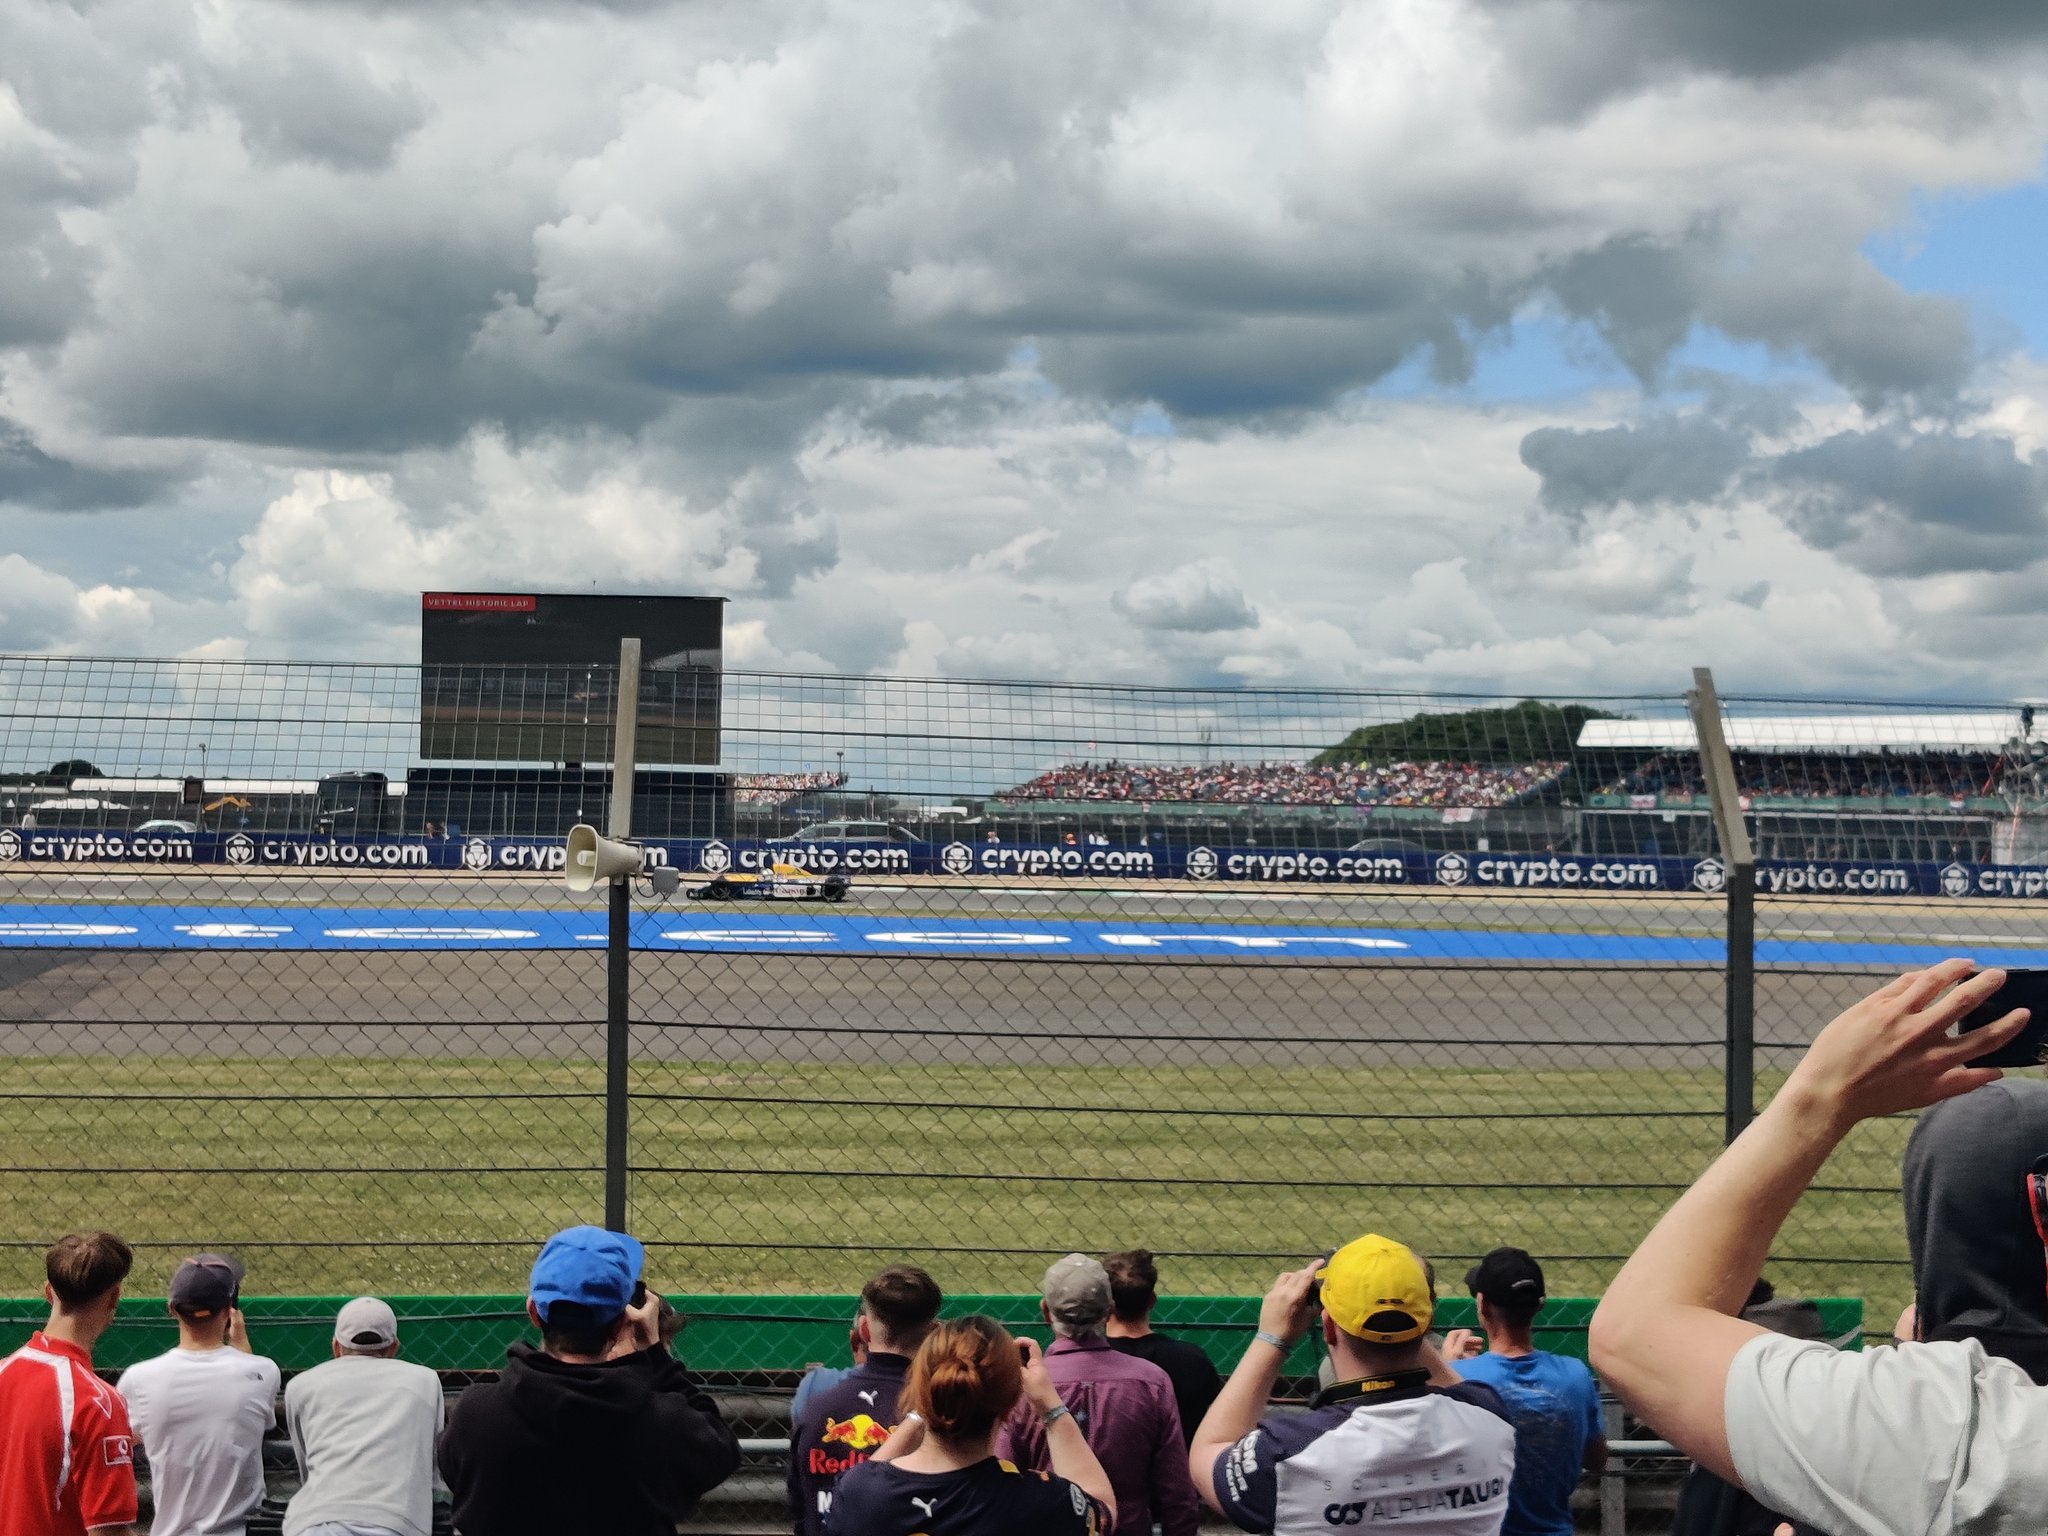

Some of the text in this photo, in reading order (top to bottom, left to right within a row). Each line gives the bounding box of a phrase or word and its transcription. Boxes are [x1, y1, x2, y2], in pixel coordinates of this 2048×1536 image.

[31, 833, 192, 861] crypto.com
[264, 838, 428, 864] crypto.com
[740, 845, 909, 869] crypto.com
[981, 847, 1153, 873] crypto.com
[1227, 853, 1403, 879] crypto.com
[1477, 858, 1658, 885] crypto.com
[1754, 864, 1907, 891] rypto.com
